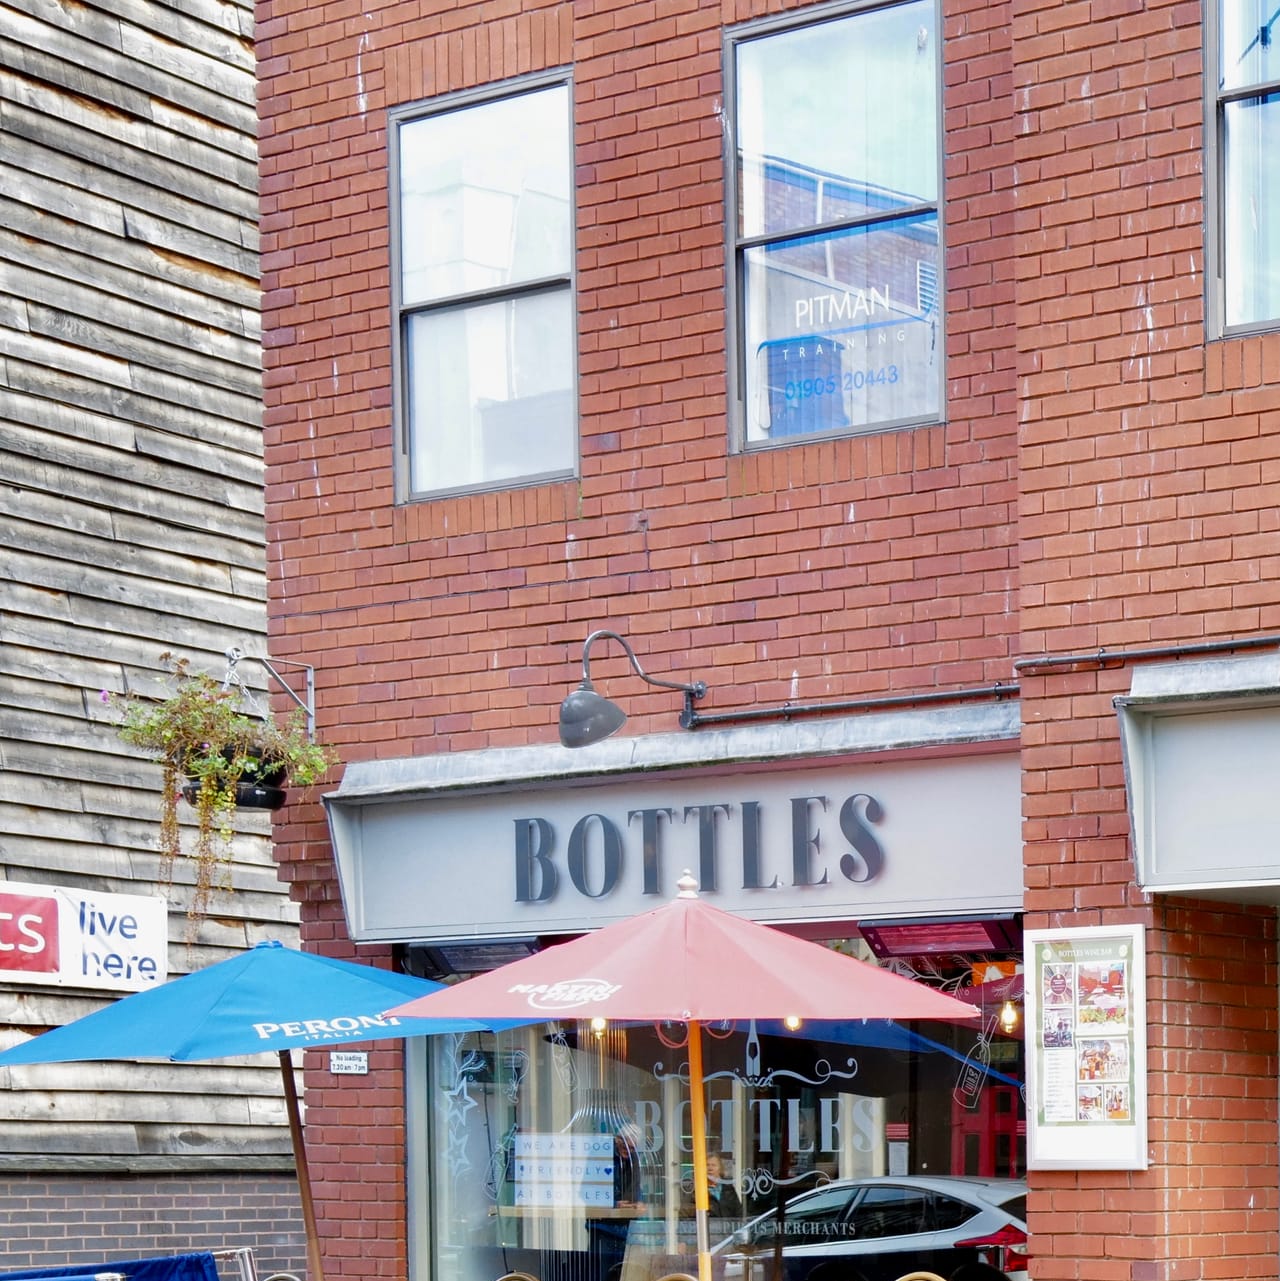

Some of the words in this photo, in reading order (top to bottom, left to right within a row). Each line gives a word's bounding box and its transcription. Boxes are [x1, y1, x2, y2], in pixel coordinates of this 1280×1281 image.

[796, 284, 889, 328] PITMAN
[783, 329, 905, 360] TRAINING
[785, 375, 836, 401] 01905
[843, 364, 898, 391] 20443
[514, 793, 883, 903] BOTTLES
[80, 901, 138, 939] live
[82, 944, 157, 981] here
[252, 1012, 402, 1039] PERONI
[634, 1098, 884, 1153] BOTTLES
[584, 1143, 611, 1151] DOG
[772, 1223, 856, 1236] MERCHANTS
